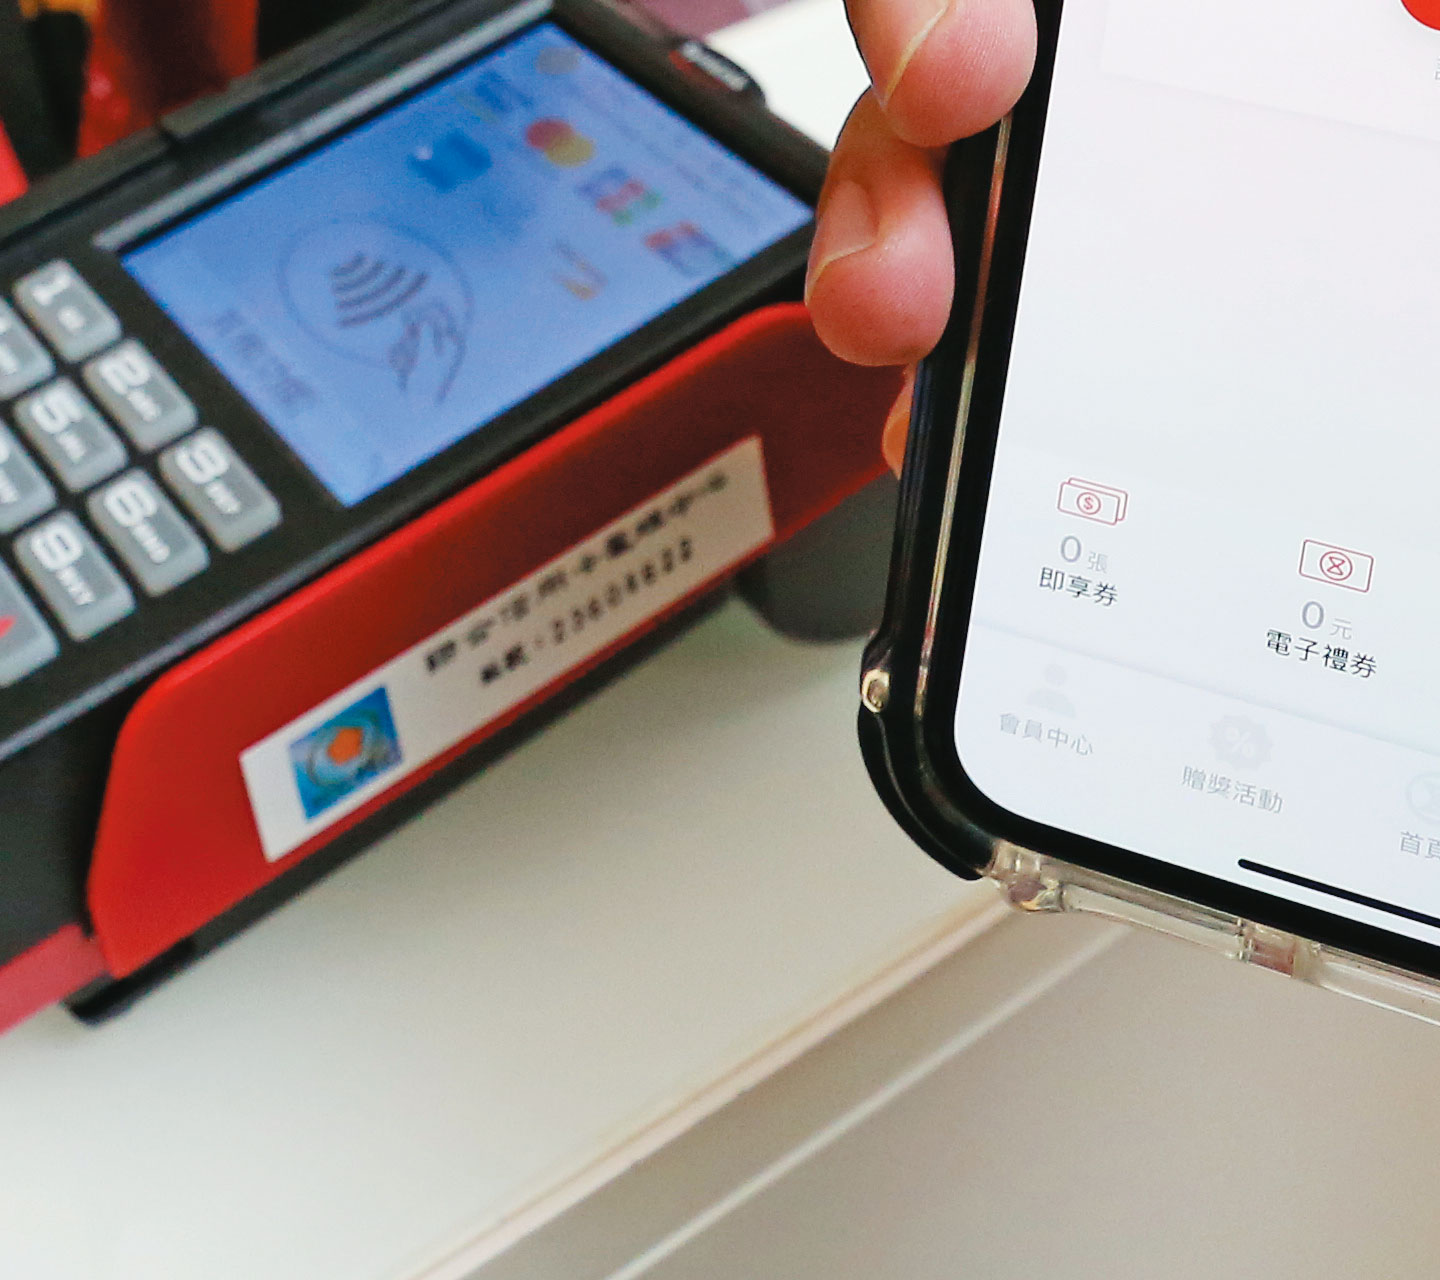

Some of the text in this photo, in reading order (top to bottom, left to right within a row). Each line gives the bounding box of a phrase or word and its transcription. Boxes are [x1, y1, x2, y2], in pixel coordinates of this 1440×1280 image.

[1060, 535, 1108, 574] 0 張
[1039, 566, 1119, 608] 即享券
[1301, 600, 1353, 640] 0 元
[1265, 629, 1378, 679] 電子禮券
[999, 712, 1094, 756] 會員中心
